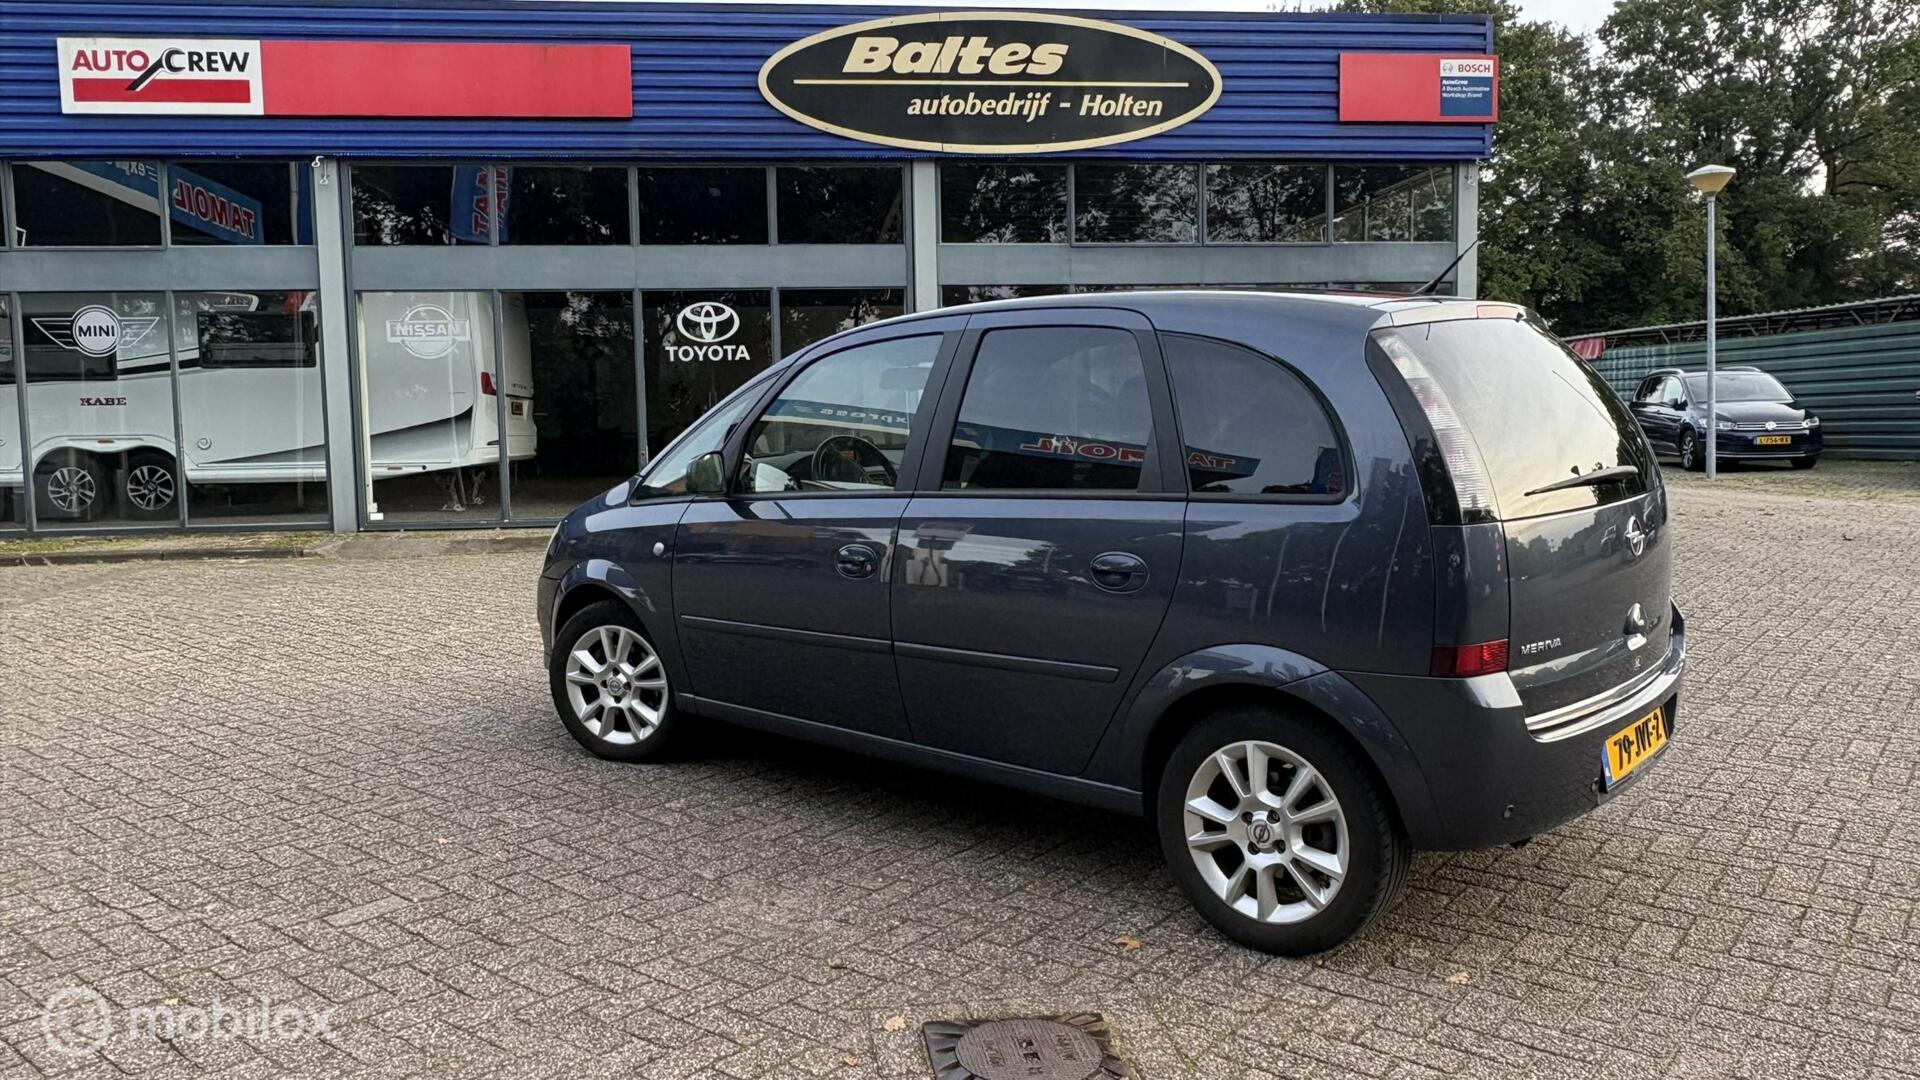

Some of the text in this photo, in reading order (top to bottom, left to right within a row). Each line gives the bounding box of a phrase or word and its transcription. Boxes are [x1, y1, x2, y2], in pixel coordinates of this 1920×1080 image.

[72, 49, 250, 73] AUTO CREW
[842, 36, 1069, 75] Baltes
[1457, 64, 1491, 73] BOSCH
[906, 92, 1052, 123] autobedrijf
[1079, 94, 1163, 117] Holten
[78, 325, 116, 338] MINI
[396, 323, 460, 337] NISSAN
[664, 344, 751, 362] TOYOTA
[80, 397, 127, 407] KABE
[1521, 637, 1562, 655] MERIVA
[1613, 712, 1663, 772] 79-JVF-2
